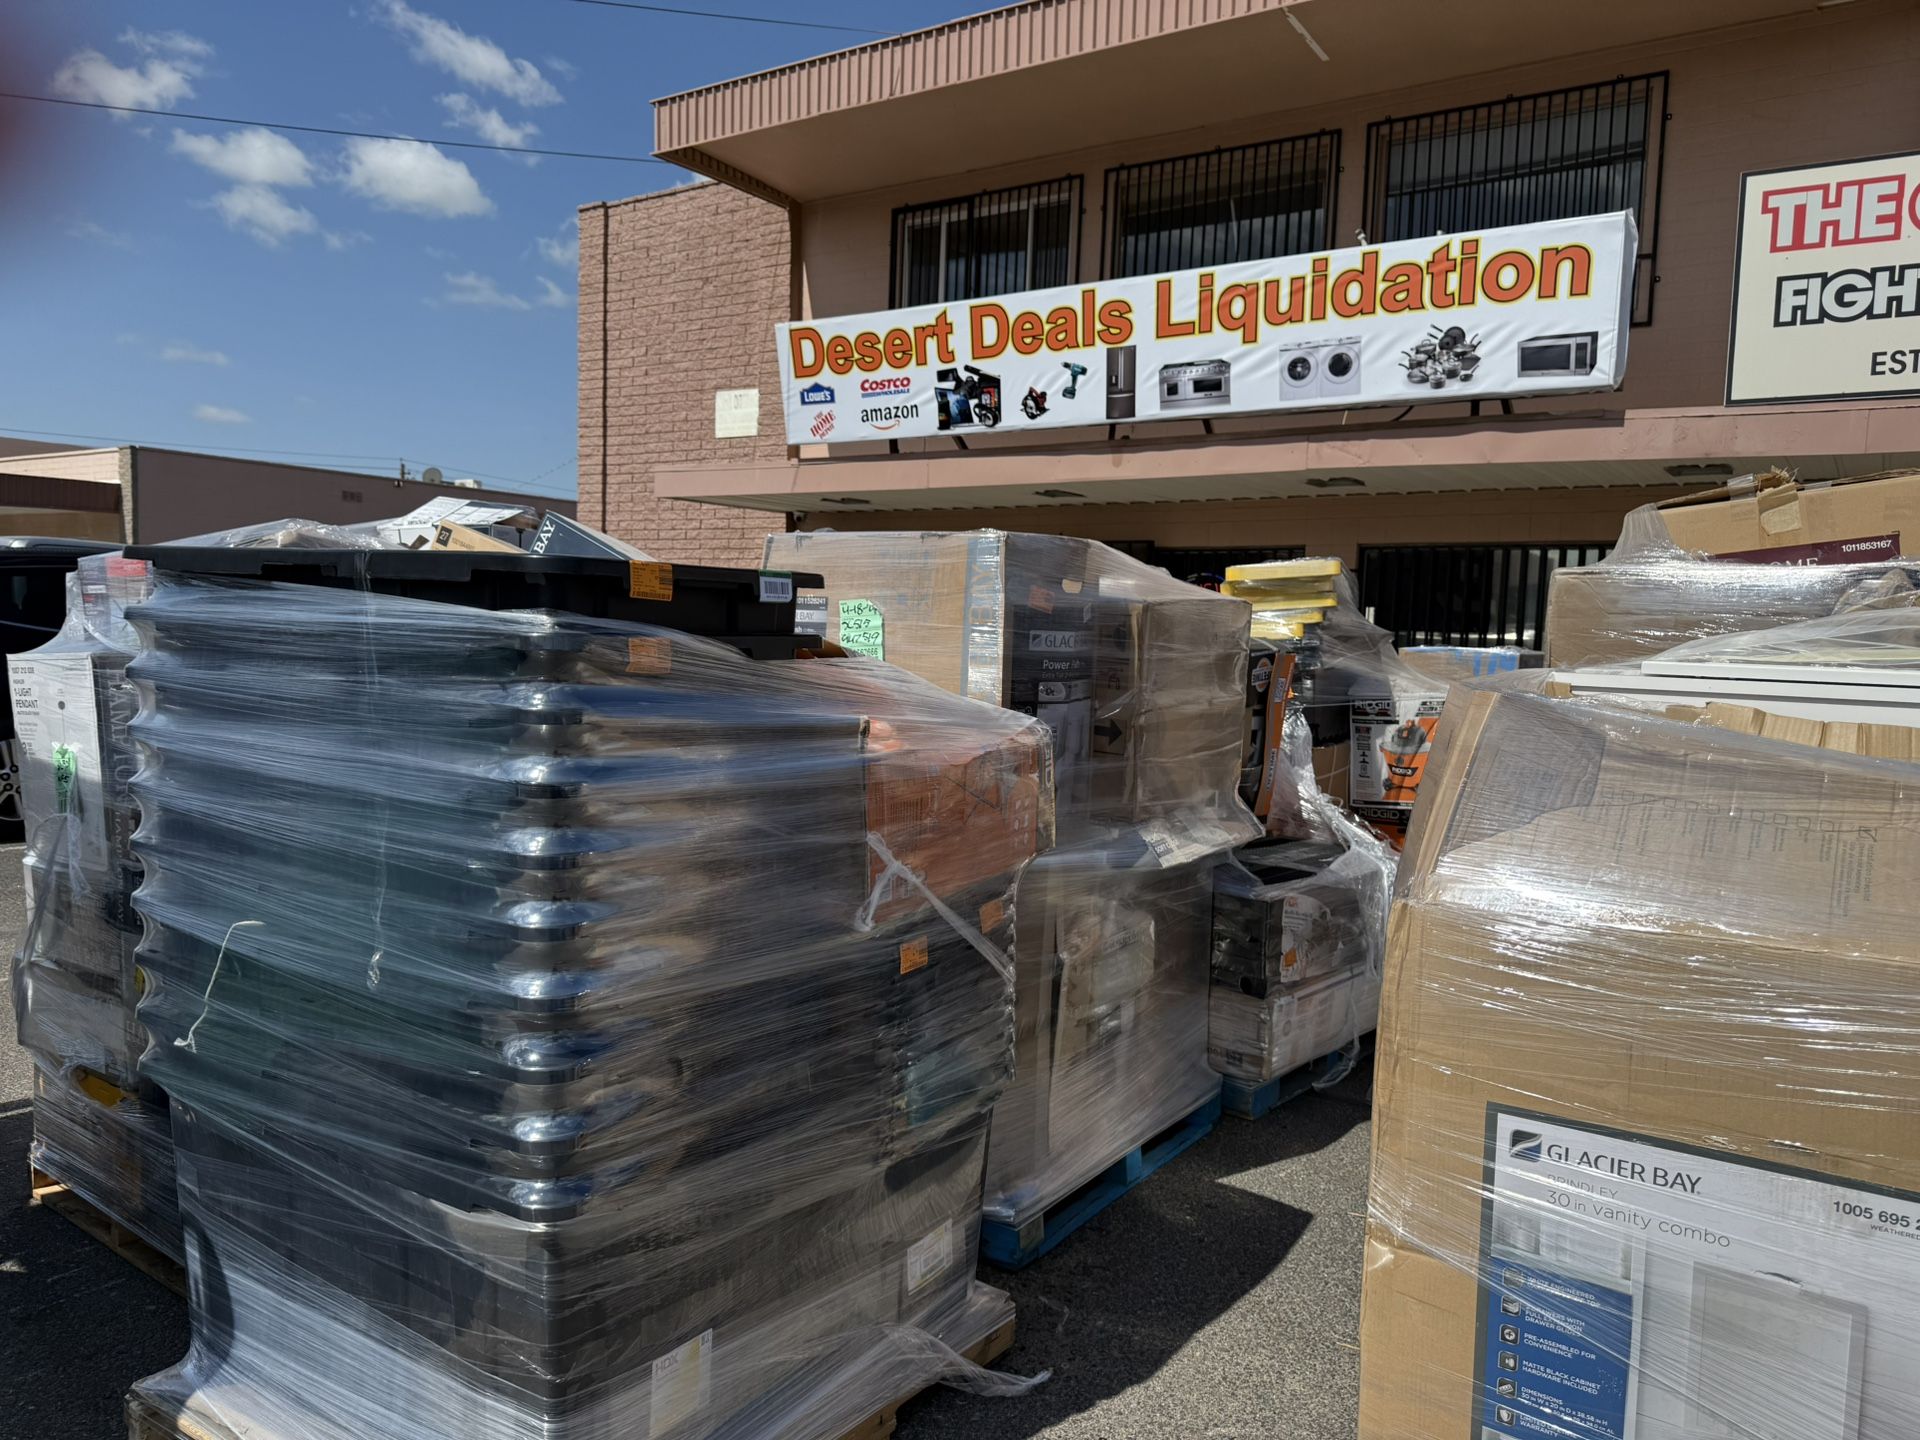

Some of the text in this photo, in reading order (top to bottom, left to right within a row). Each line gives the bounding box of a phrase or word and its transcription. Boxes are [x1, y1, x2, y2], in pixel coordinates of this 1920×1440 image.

[1761, 174, 1906, 253] THE
[1774, 262, 1920, 328] FIGH
[789, 238, 1593, 379] Desert Deals Liquidation
[860, 376, 911, 392] COSTCO
[804, 389, 832, 402] LOWE'S
[861, 403, 919, 423] amazon
[810, 410, 836, 438] HOME
[440, 529, 450, 541] 27
[534, 520, 556, 554] BAY
[1841, 539, 1892, 553] 1011853167
[1043, 659, 1070, 671] Power
[1358, 807, 1400, 819] RIDGID
[1547, 1144, 1702, 1194] GLACIER BAY
[1547, 1189, 1731, 1248] 30 in vanity combo
[1833, 1200, 1873, 1219] 1005
[1879, 1210, 1910, 1228] 695
[1525, 1316, 1555, 1330] DRAWER
[1566, 1316, 1586, 1327] WITH
[1524, 1332, 1596, 1360] PRE-ASSEMBLED FOR
[1524, 1338, 1573, 1359] CONVENIENCE
[1522, 1360, 1601, 1390] MATTE BLACK CABINET
[1522, 1366, 1598, 1395] HARDWARE INCLUDED
[1521, 1386, 1563, 1405] DIMENSIONS
[1520, 1420, 1559, 1438] WARRANTY
